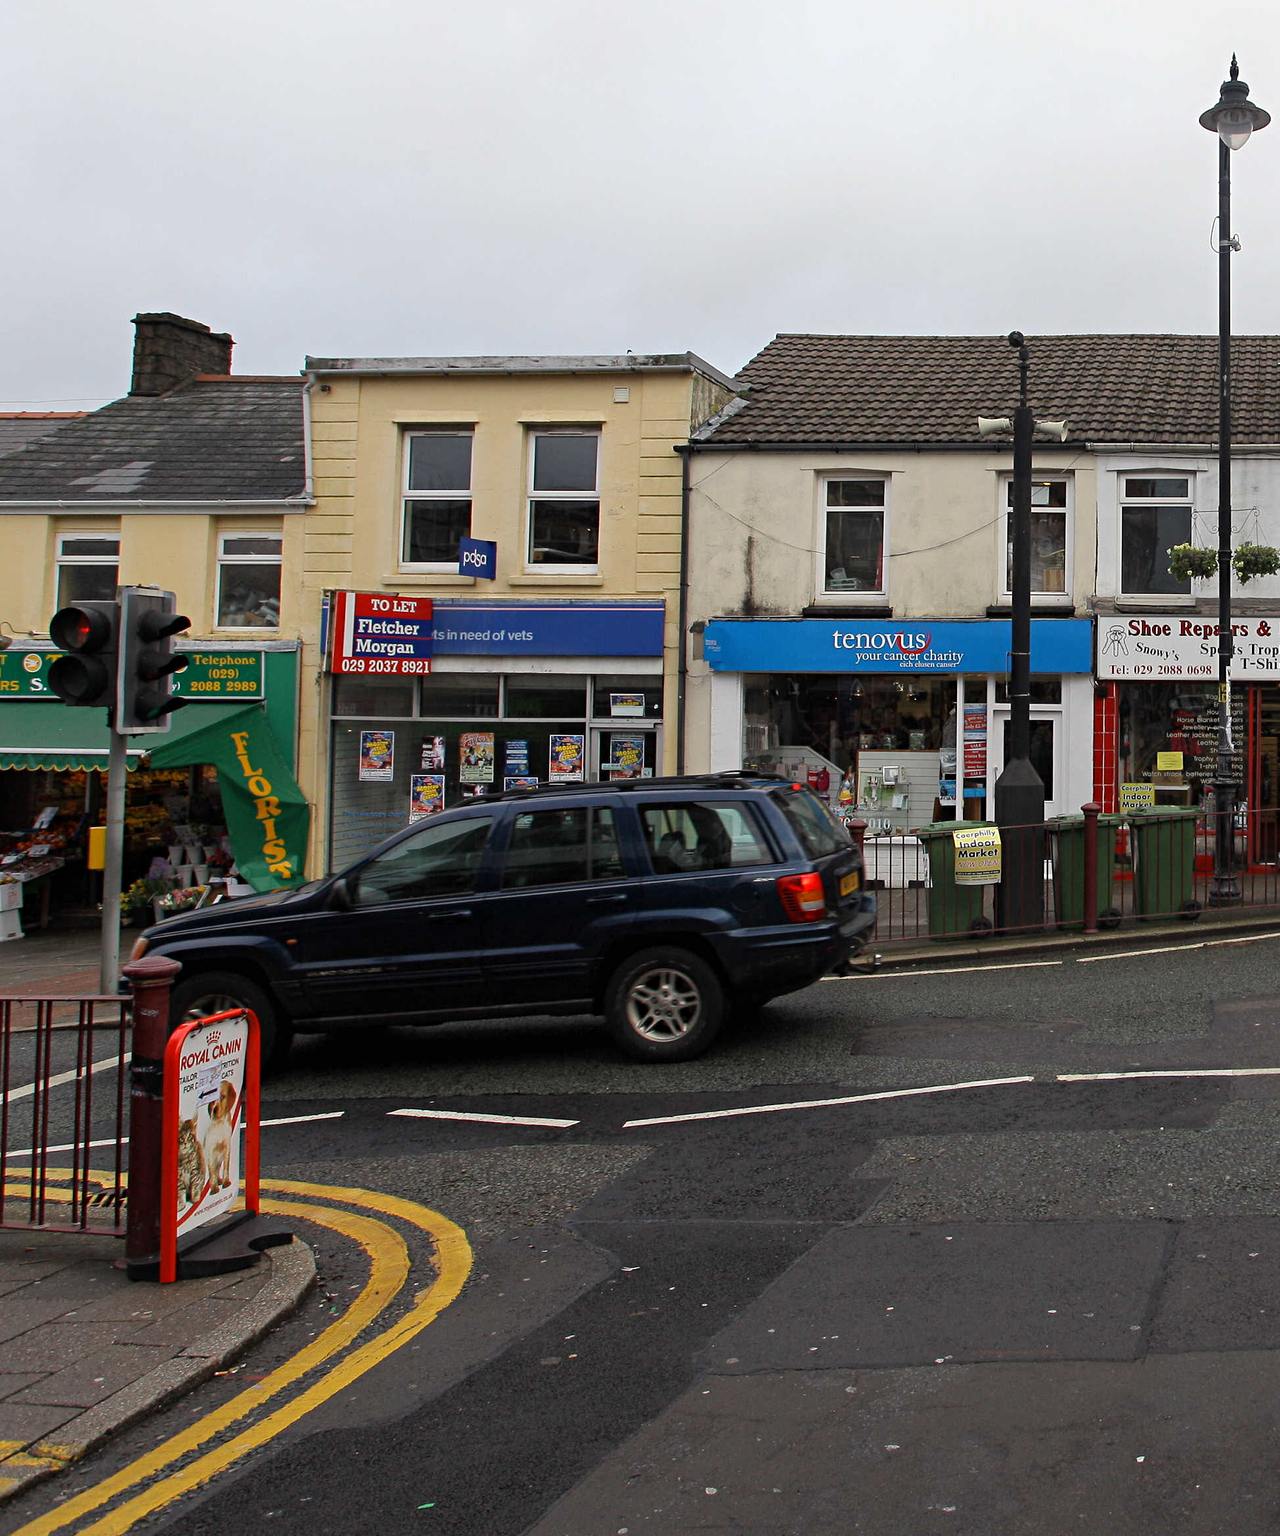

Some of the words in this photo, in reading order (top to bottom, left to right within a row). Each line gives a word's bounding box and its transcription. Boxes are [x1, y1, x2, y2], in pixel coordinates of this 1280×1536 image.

[463, 549, 487, 567] pdsa
[371, 599, 390, 611] TO
[393, 600, 417, 613] LET
[358, 618, 419, 636] Fletcher
[1128, 619, 1171, 636] Shoe
[1179, 620, 1248, 640] Repars
[1256, 620, 1271, 637] &
[433, 630, 444, 640] ts
[447, 630, 458, 640] in
[460, 630, 490, 640] need
[492, 630, 505, 640] of
[508, 630, 533, 640] vets
[833, 630, 926, 649] tenovus
[356, 639, 414, 656] Morgan
[1135, 642, 1180, 661] Snowy's
[1200, 643, 1243, 657] Spts
[193, 655, 256, 666] Telephone
[855, 652, 881, 664] your
[884, 652, 920, 661] cancer
[923, 650, 964, 664] charity
[342, 659, 365, 672] 029
[368, 660, 399, 672] 2037
[402, 660, 430, 673] 8921
[1109, 665, 1129, 674] Tel:
[1134, 665, 1153, 675] 029
[1157, 665, 1182, 675] 2088
[1187, 665, 1212, 675] 0698
[208, 669, 239, 679] (029)
[190, 682, 220, 691] 2088
[226, 682, 256, 691] 2989
[230, 732, 292, 879] FLORIST
[956, 830, 995, 839] Caerphilly
[959, 839, 995, 848] Indoor
[958, 848, 998, 858] Market
[180, 1049, 210, 1071] ROYAL
[213, 1038, 242, 1059] CANIN
[183, 1084, 194, 1093] FOR
[222, 1069, 234, 1079] CATS
